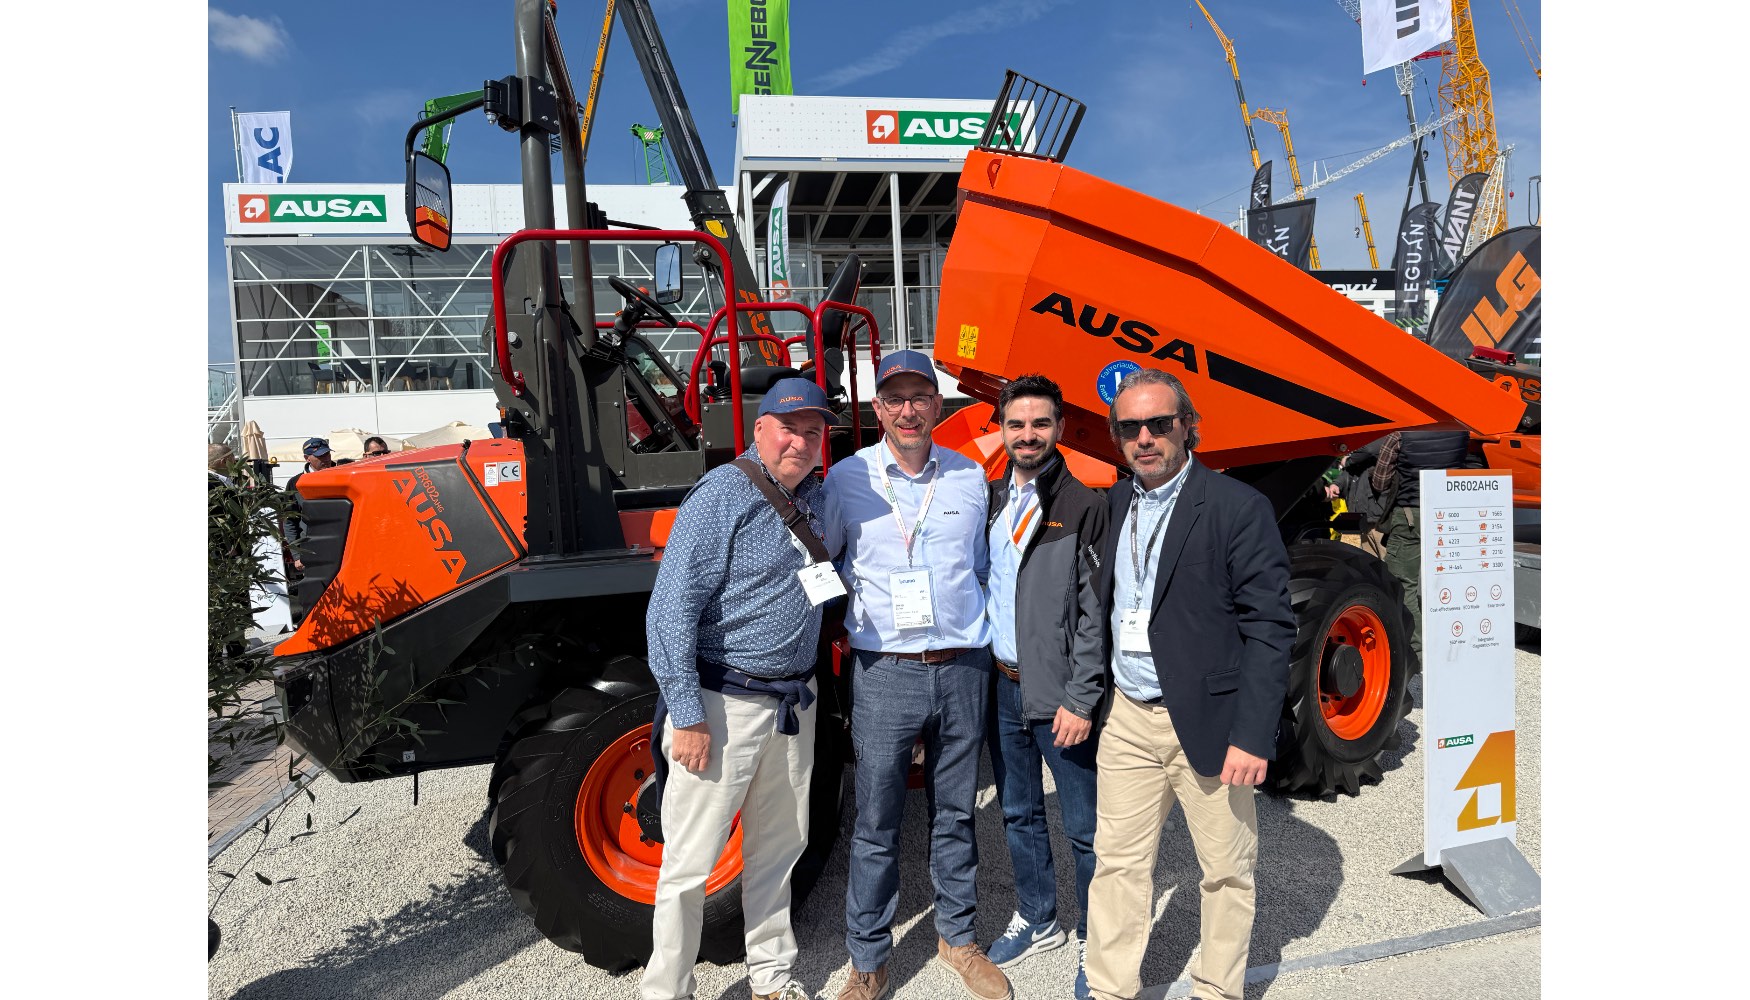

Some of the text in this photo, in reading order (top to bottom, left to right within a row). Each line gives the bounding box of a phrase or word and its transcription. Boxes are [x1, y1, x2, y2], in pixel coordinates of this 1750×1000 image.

[903, 118, 1014, 140] AUSA
[254, 127, 284, 184] AC
[273, 198, 383, 218] AUSA
[772, 209, 785, 279] AUSA
[1443, 188, 1477, 266] AVANT
[1030, 292, 1200, 374] AUSA
[779, 396, 804, 404] AUSA
[501, 464, 519, 478] CE
[1446, 480, 1500, 492] DR602AHG
[414, 465, 445, 513] DR602AHG
[392, 471, 467, 585] AUSA
[1446, 735, 1474, 747] AUSA
